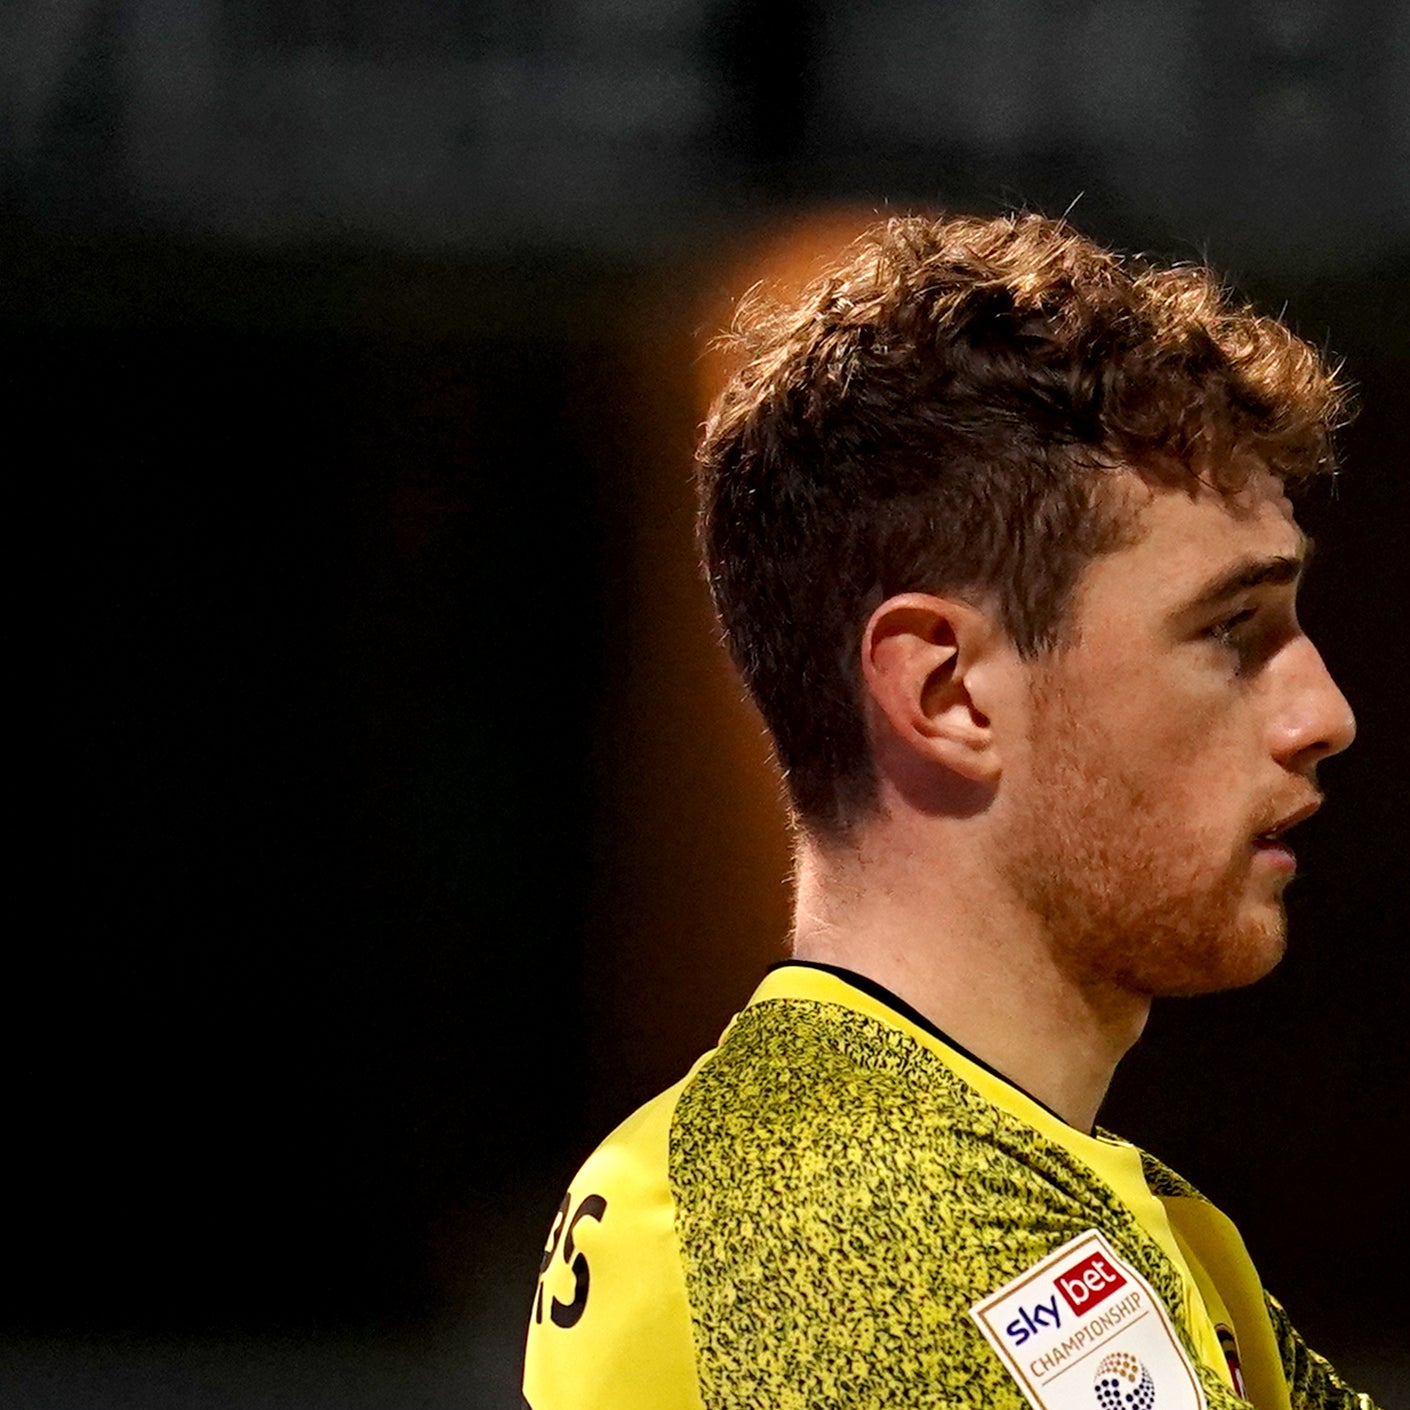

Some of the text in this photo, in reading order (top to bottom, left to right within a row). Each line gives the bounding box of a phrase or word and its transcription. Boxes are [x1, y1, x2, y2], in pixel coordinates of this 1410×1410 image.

[1006, 1260, 1117, 1346] sky bet
[1030, 1291, 1141, 1377] CHAMPIONSHIP
